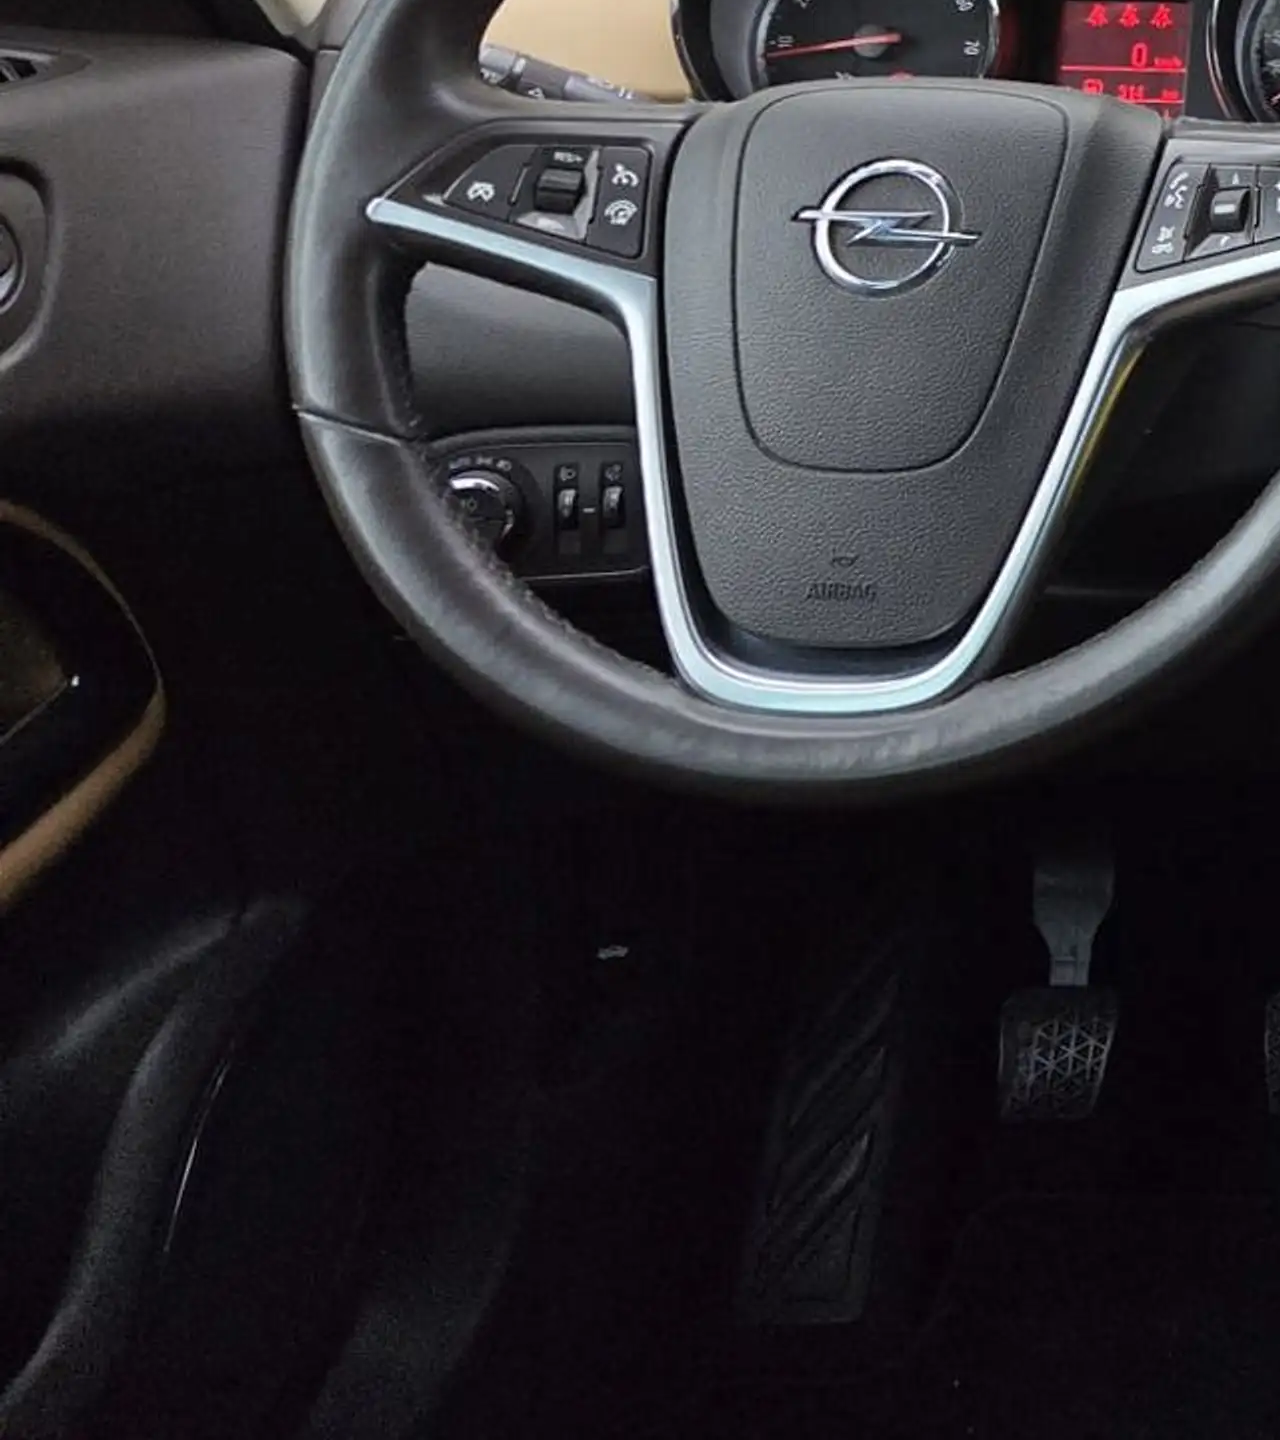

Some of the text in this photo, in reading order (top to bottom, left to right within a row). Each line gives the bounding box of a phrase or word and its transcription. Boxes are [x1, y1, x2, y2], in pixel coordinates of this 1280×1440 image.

[777, 35, 795, 48] 10
[963, 40, 980, 56] 70
[1131, 42, 1148, 68] 0
